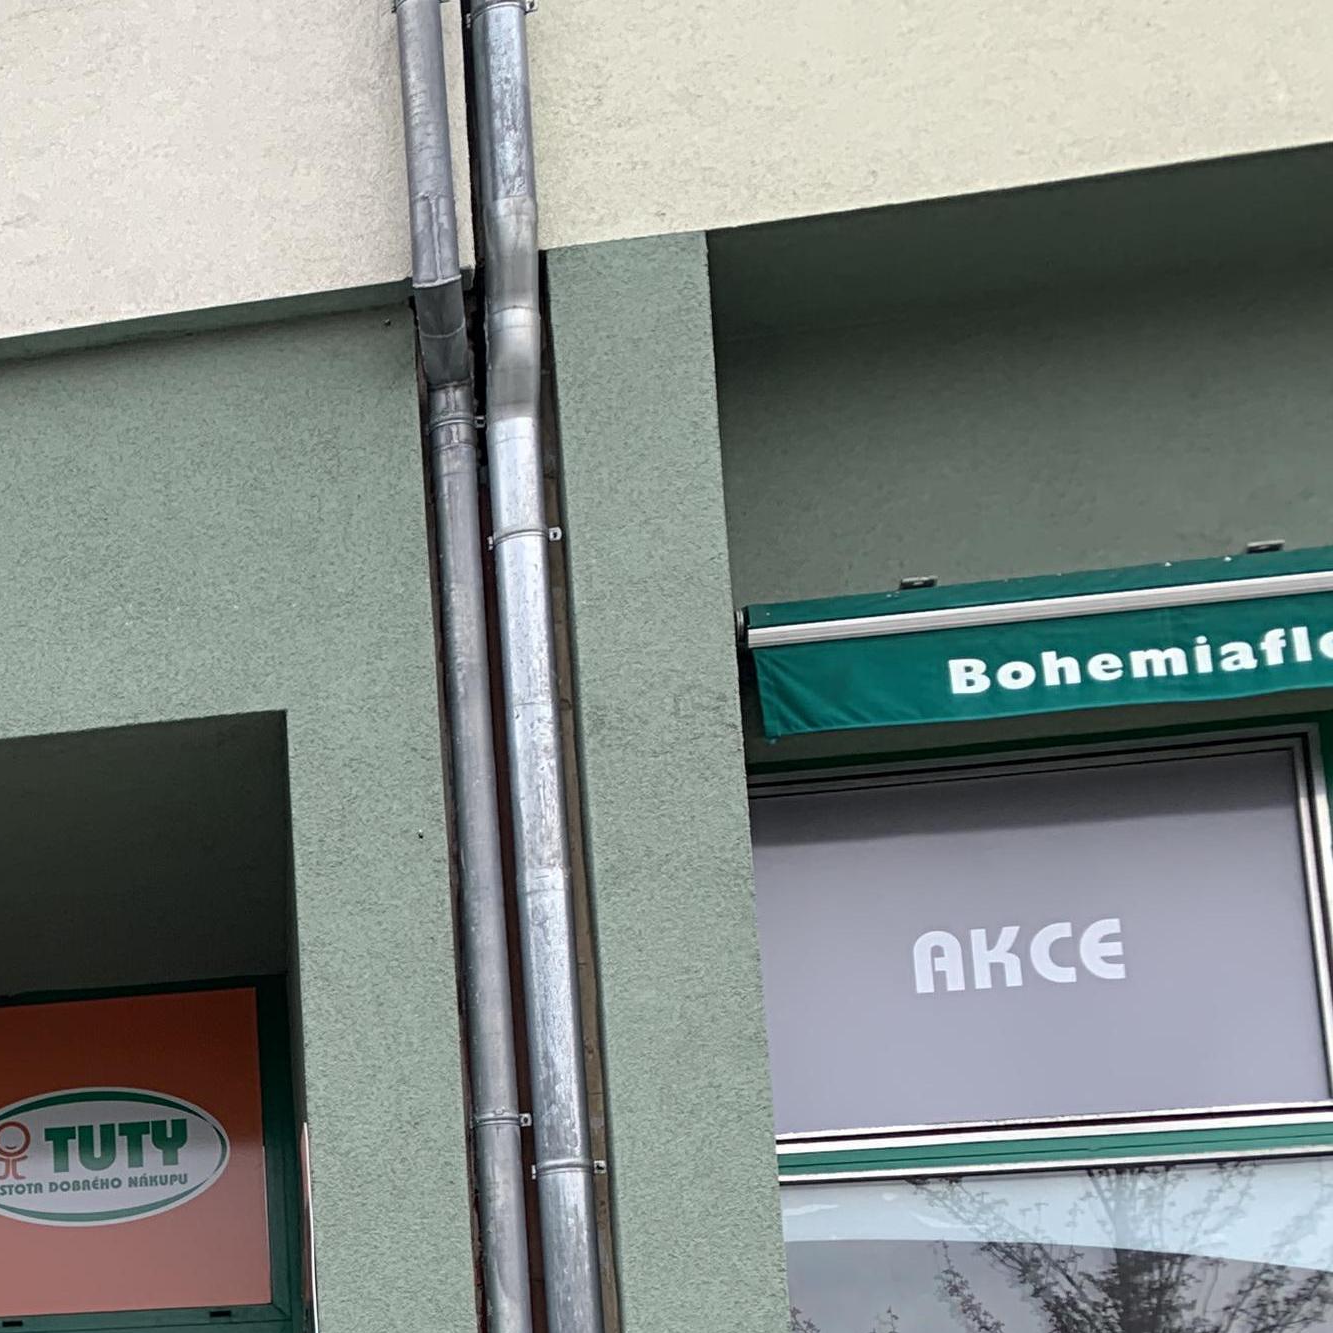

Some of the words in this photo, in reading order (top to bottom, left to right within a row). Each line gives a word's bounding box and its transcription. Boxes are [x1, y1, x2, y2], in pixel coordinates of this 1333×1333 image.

[913, 918, 1126, 994] AKCE
[44, 1118, 188, 1174] TUTY
[49, 1176, 122, 1193] DOBRÉHO
[128, 1173, 188, 1188] NÁKUPU
